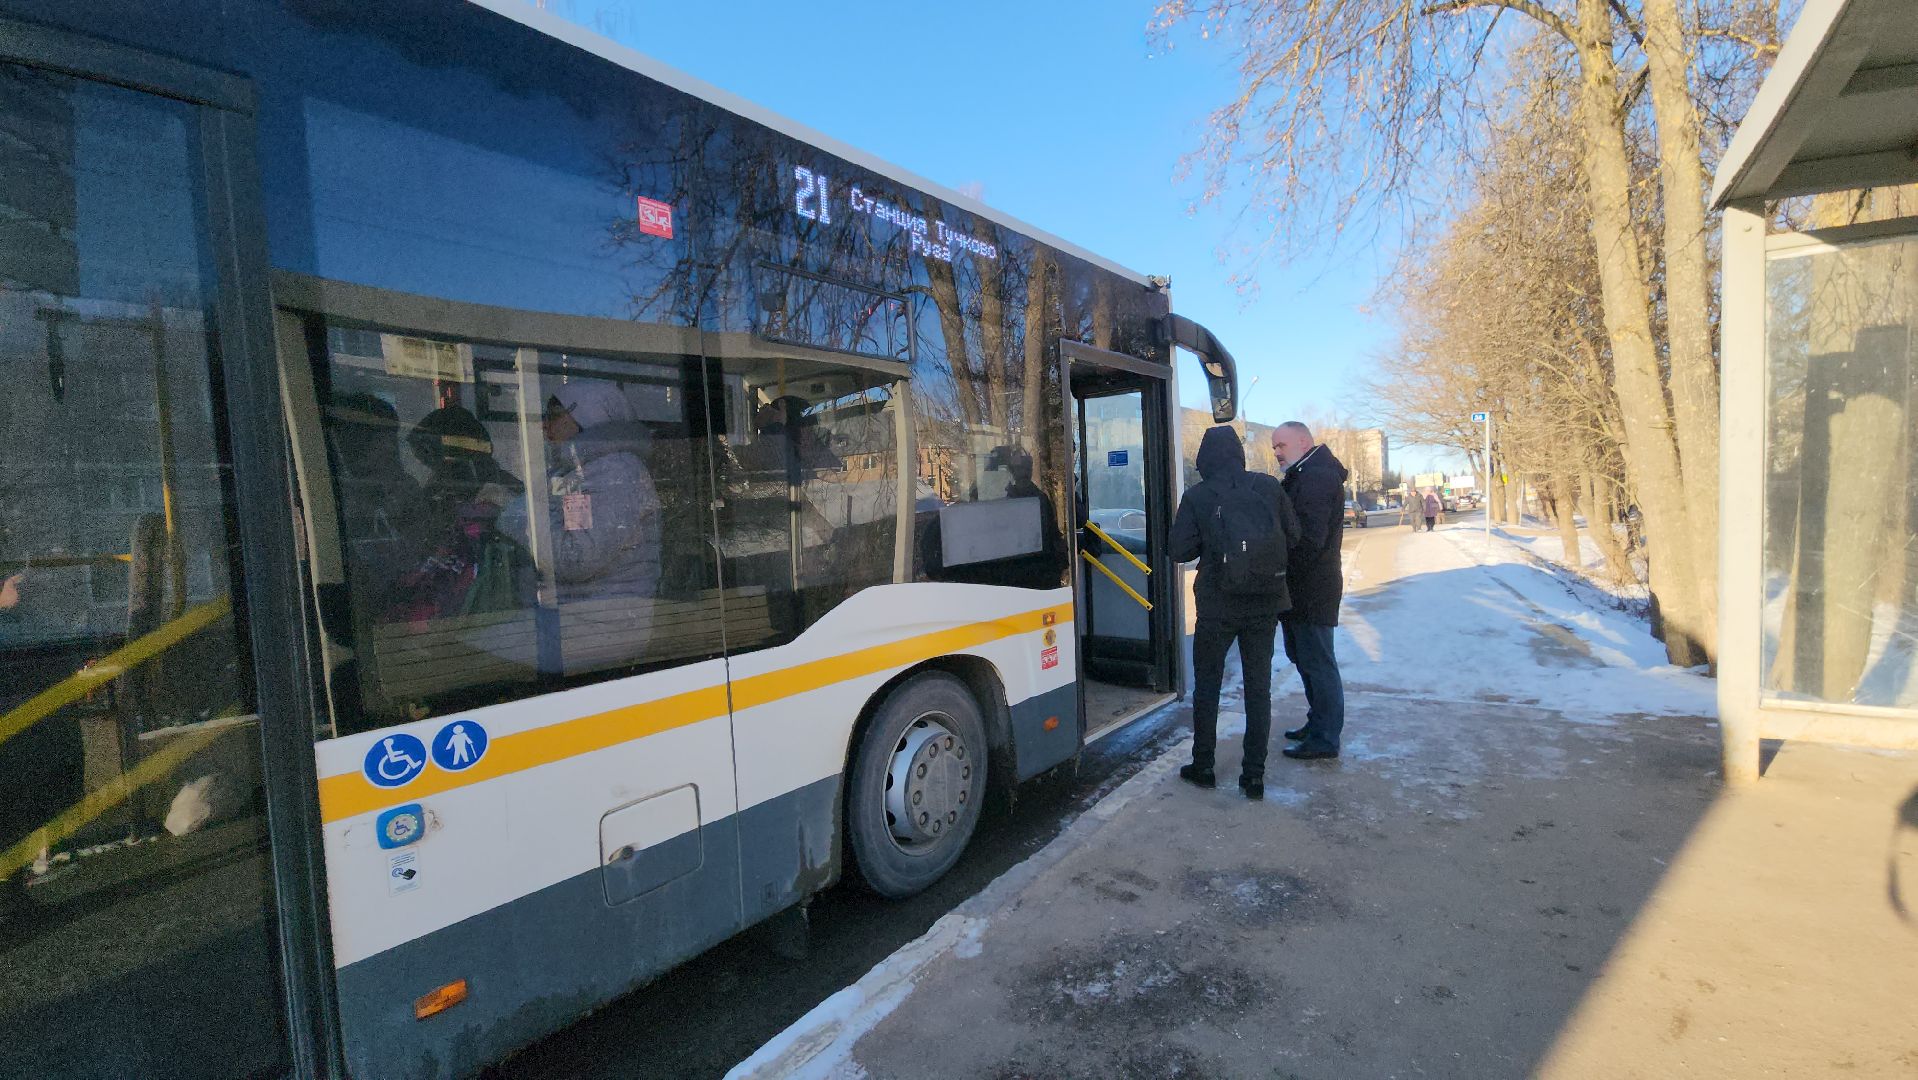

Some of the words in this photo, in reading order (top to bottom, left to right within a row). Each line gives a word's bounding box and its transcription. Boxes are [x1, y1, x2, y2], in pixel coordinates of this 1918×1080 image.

[795, 166, 830, 225] 21
[851, 187, 928, 235] Станция
[935, 220, 996, 260] Тучково
[911, 231, 950, 262] Руза
